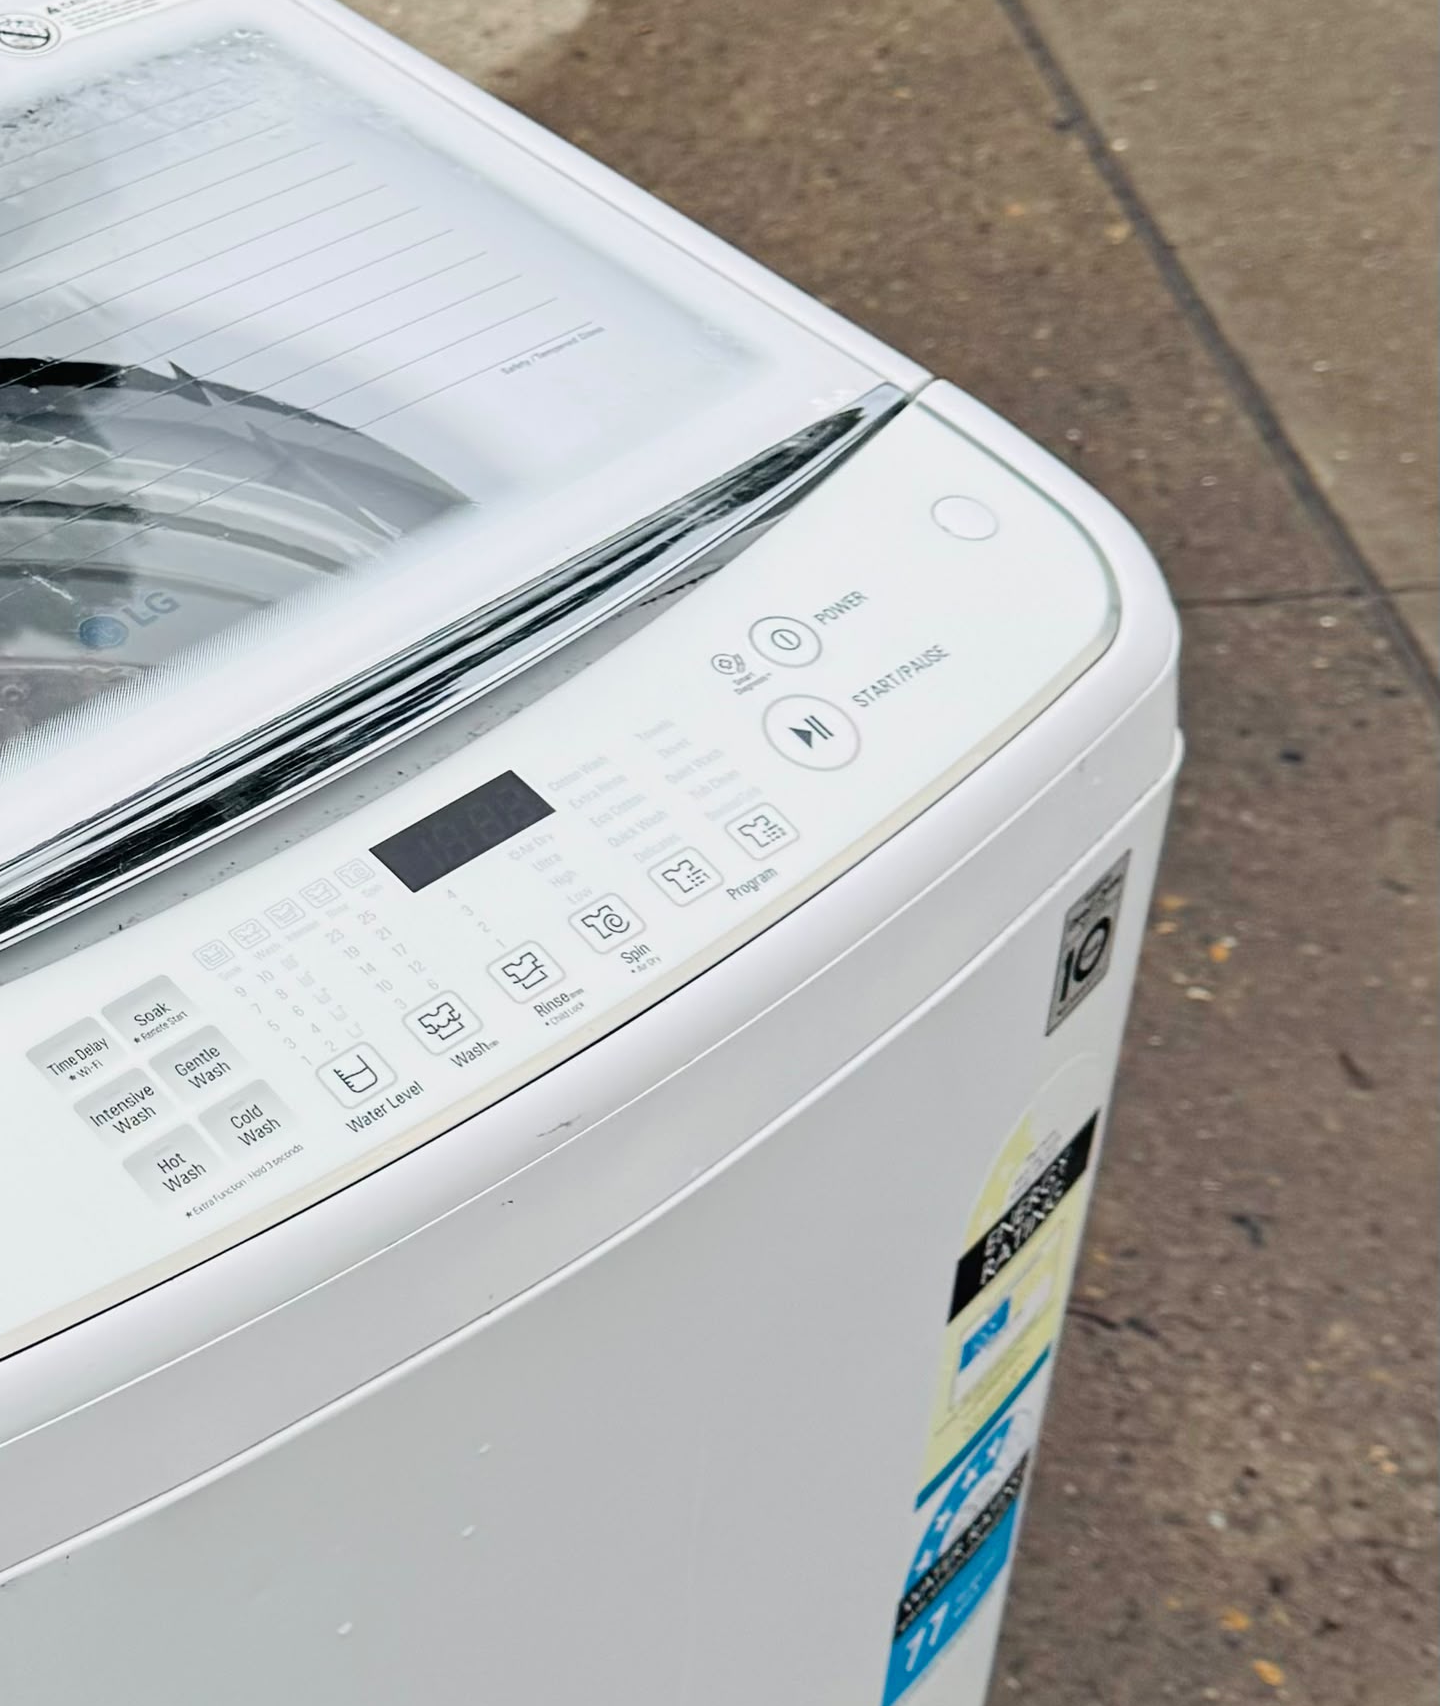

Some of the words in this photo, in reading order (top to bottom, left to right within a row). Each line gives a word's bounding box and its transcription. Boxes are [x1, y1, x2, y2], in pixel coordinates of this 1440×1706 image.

[121, 591, 181, 628] LG
[813, 591, 869, 625] POWER
[852, 644, 950, 708] START/PAUSE
[726, 867, 778, 901] Program
[357, 909, 377, 926] 25
[461, 903, 474, 917] 3
[324, 927, 345, 944] 23
[375, 925, 393, 941] 21
[477, 920, 491, 934] 2
[391, 942, 408, 957] 17
[620, 943, 652, 964] Spin
[256, 969, 275, 984] 10
[359, 961, 377, 976] 14
[408, 959, 427, 976] 12
[375, 978, 394, 993] 10
[427, 978, 440, 990] 6
[134, 1002, 172, 1027] Soak
[533, 992, 571, 1018] Rinse
[283, 1036, 297, 1050] 3
[324, 1039, 337, 1053] 2
[449, 1039, 490, 1068] Wash
[47, 1053, 79, 1077] Time
[74, 1036, 110, 1062] Delay
[174, 1046, 221, 1078] Gentle
[187, 1060, 232, 1090] Wash
[89, 1084, 156, 1128] Intensive
[230, 1103, 264, 1130] Cold
[345, 1103, 389, 1134] Water
[385, 1080, 425, 1109] Level
[112, 1104, 157, 1135] Wash
[237, 1116, 282, 1147] Wash
[156, 1152, 187, 1175] Hot
[162, 1162, 207, 1193] Wash
